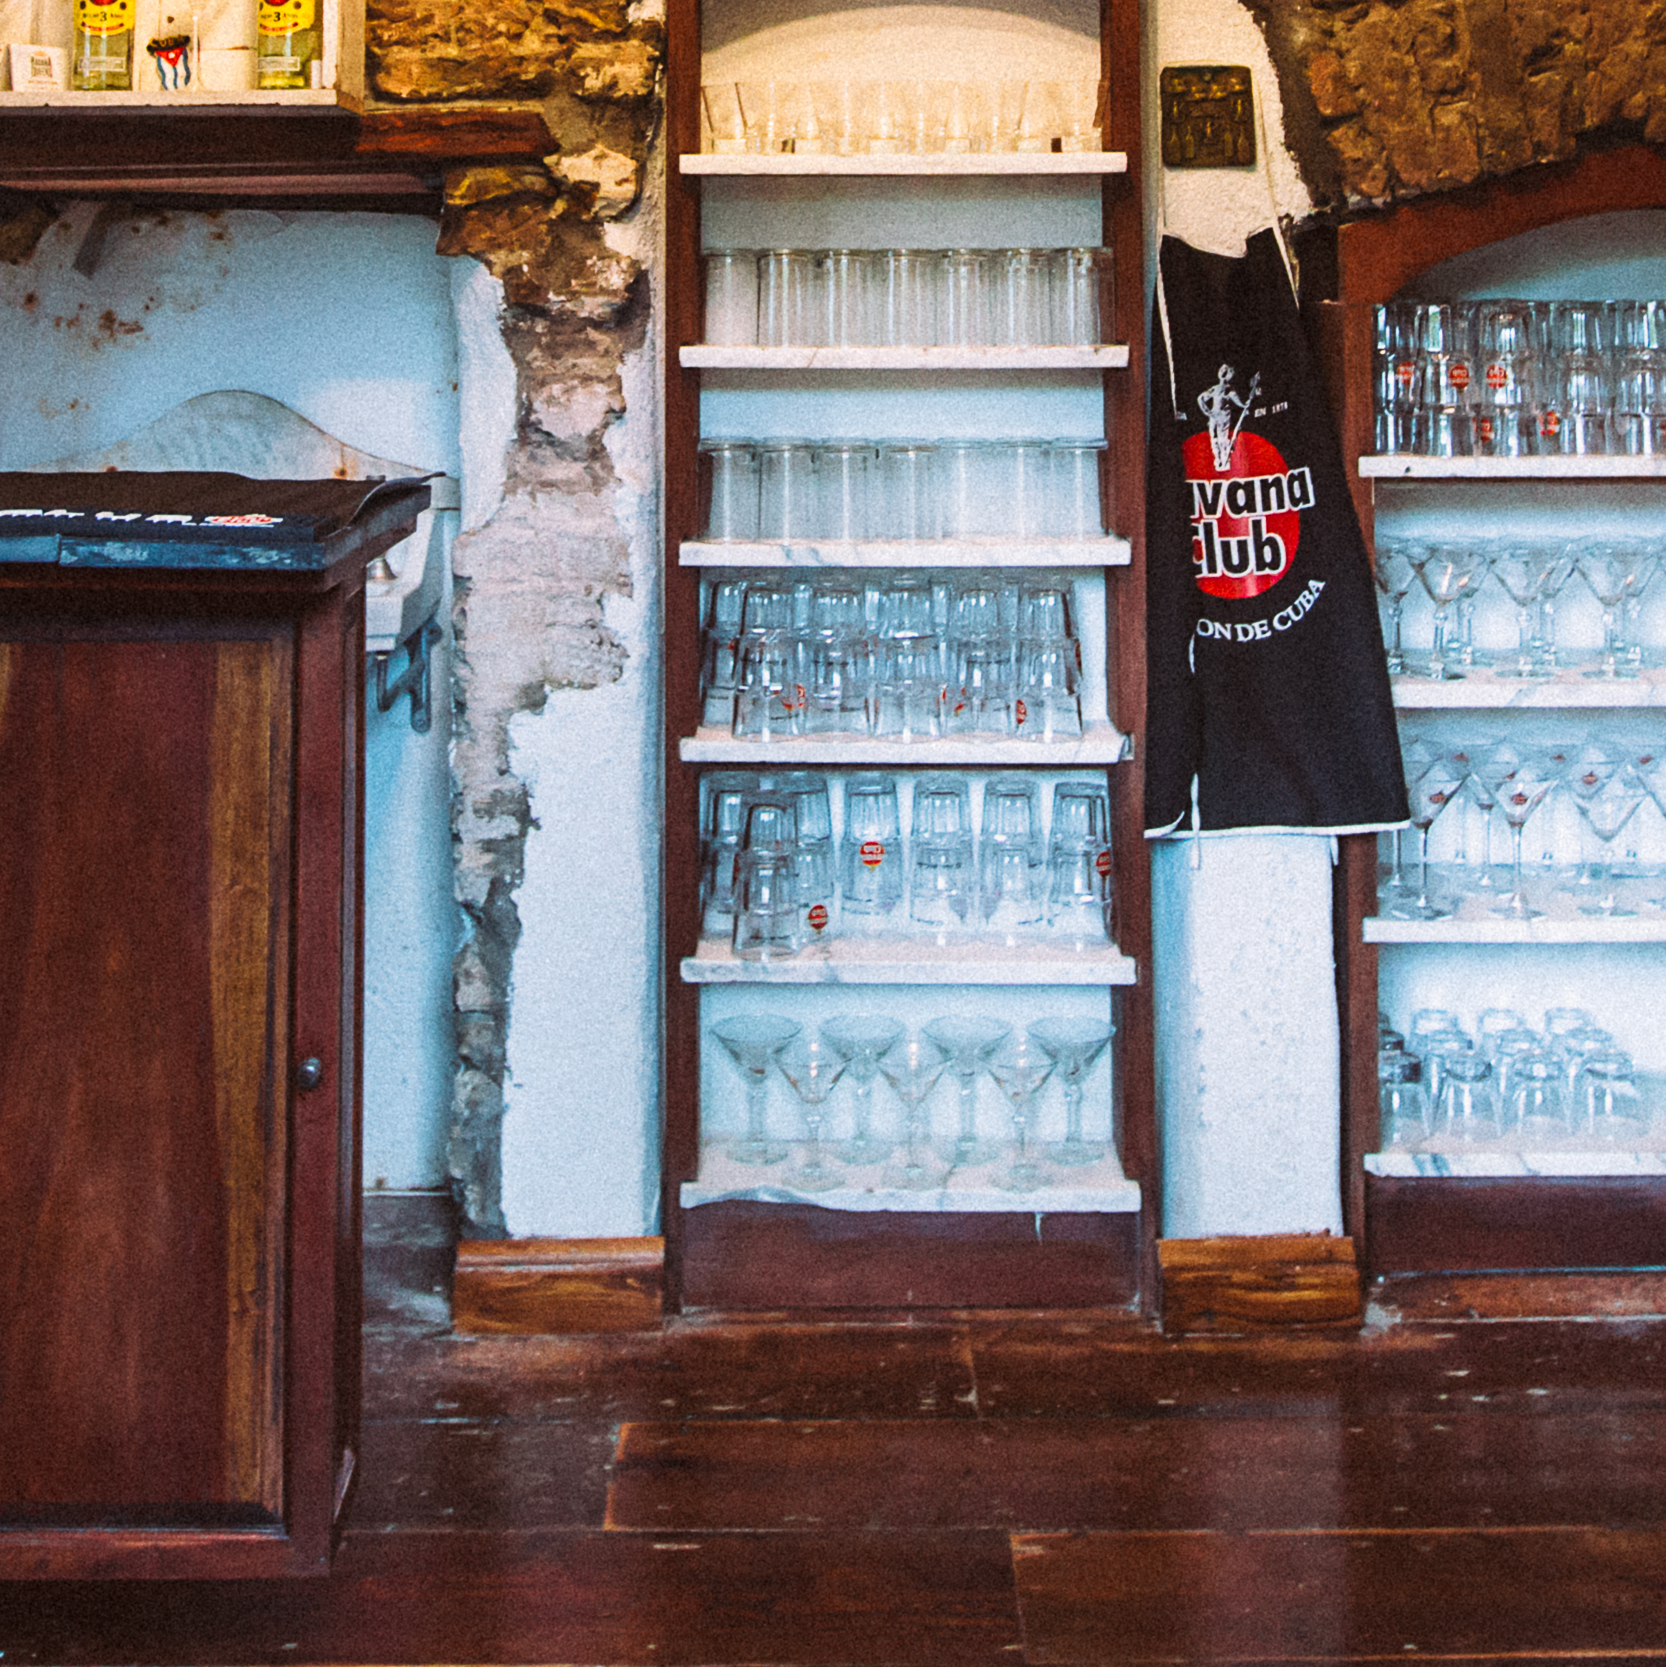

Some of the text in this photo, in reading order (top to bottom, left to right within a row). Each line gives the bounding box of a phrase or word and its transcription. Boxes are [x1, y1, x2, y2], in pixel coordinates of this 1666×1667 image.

[273, 11, 281, 22] 3
[1186, 467, 1316, 519] vana
[1234, 620, 1272, 642] DE
[1272, 579, 1326, 631] CUBA
